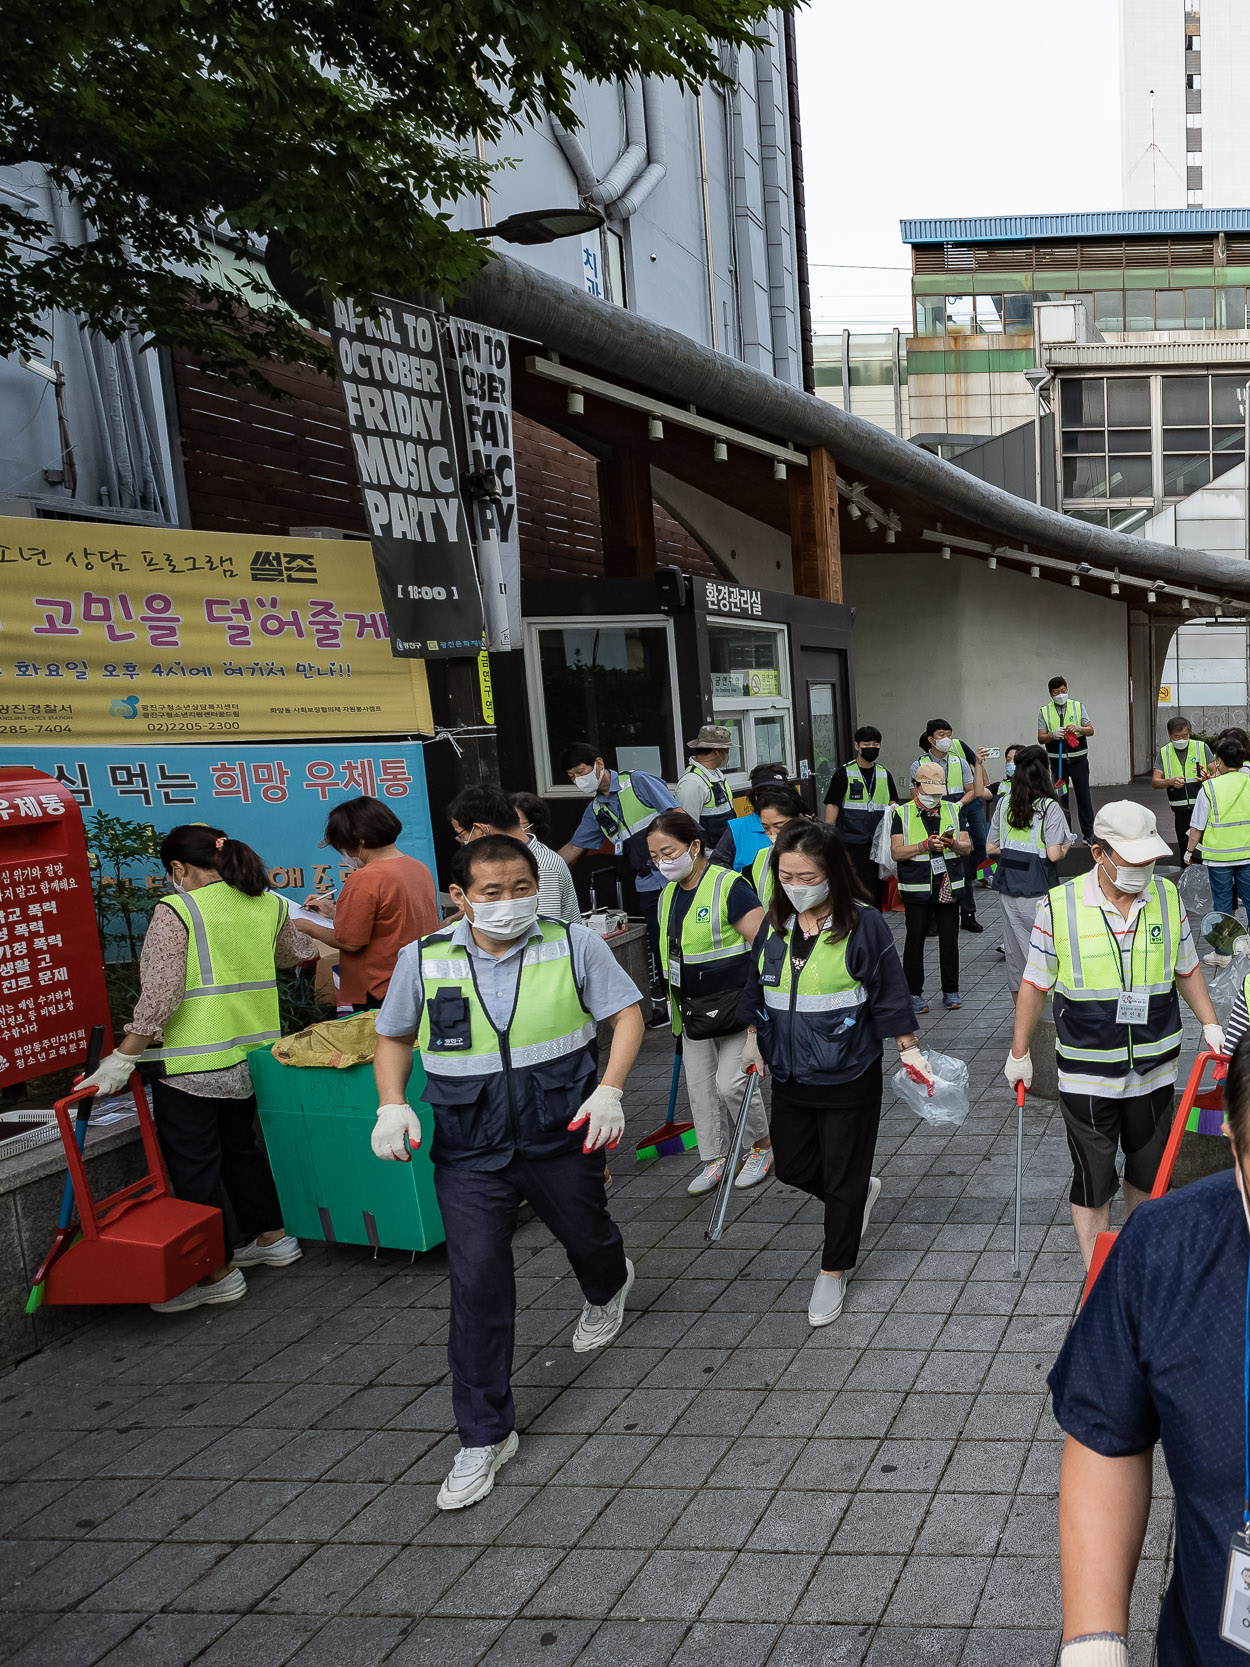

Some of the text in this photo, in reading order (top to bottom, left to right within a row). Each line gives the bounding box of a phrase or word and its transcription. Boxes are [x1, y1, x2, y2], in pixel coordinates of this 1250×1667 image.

[402, 312, 433, 353] TO
[338, 336, 441, 394] OCTOBER
[342, 380, 442, 441] FRIDAY
[351, 432, 456, 493] MUSIC
[364, 488, 459, 543] PARTY
[65, 547, 130, 572] 상담
[141, 550, 239, 579] 프로그램
[250, 550, 319, 585] 썰존
[407, 585, 447, 600] 18:00
[705, 582, 763, 616] 환경관리실
[33, 590, 183, 648] 고민을
[440, 640, 482, 649] 광진문화재
[14, 660, 352, 680] 화요일 오후 4시에 여기서 만나!!
[141, 703, 240, 712] 광진구청소년상담복지센터
[147, 721, 240, 732] 02)2205-2300
[106, 761, 198, 808] 먹는
[209, 760, 291, 804] 희망
[303, 758, 413, 801] 우체통
[13, 865, 42, 882] 위기와
[44, 862, 64, 877] 절망
[15, 884, 38, 899] 말고
[40, 877, 79, 896] 함께해요
[27, 900, 58, 917] 폭력
[14, 920, 45, 937] 폭력
[33, 933, 63, 951] 폭력
[0, 953, 53, 977] 생활 고
[1, 966, 69, 995] 진로 문제
[18, 997, 35, 1011] 매일
[37, 987, 72, 1006] 수거하며
[28, 1009, 37, 1021] 등
[40, 999, 75, 1017] 비밀보장
[14, 1028, 86, 1057] 화양동주민자치회
